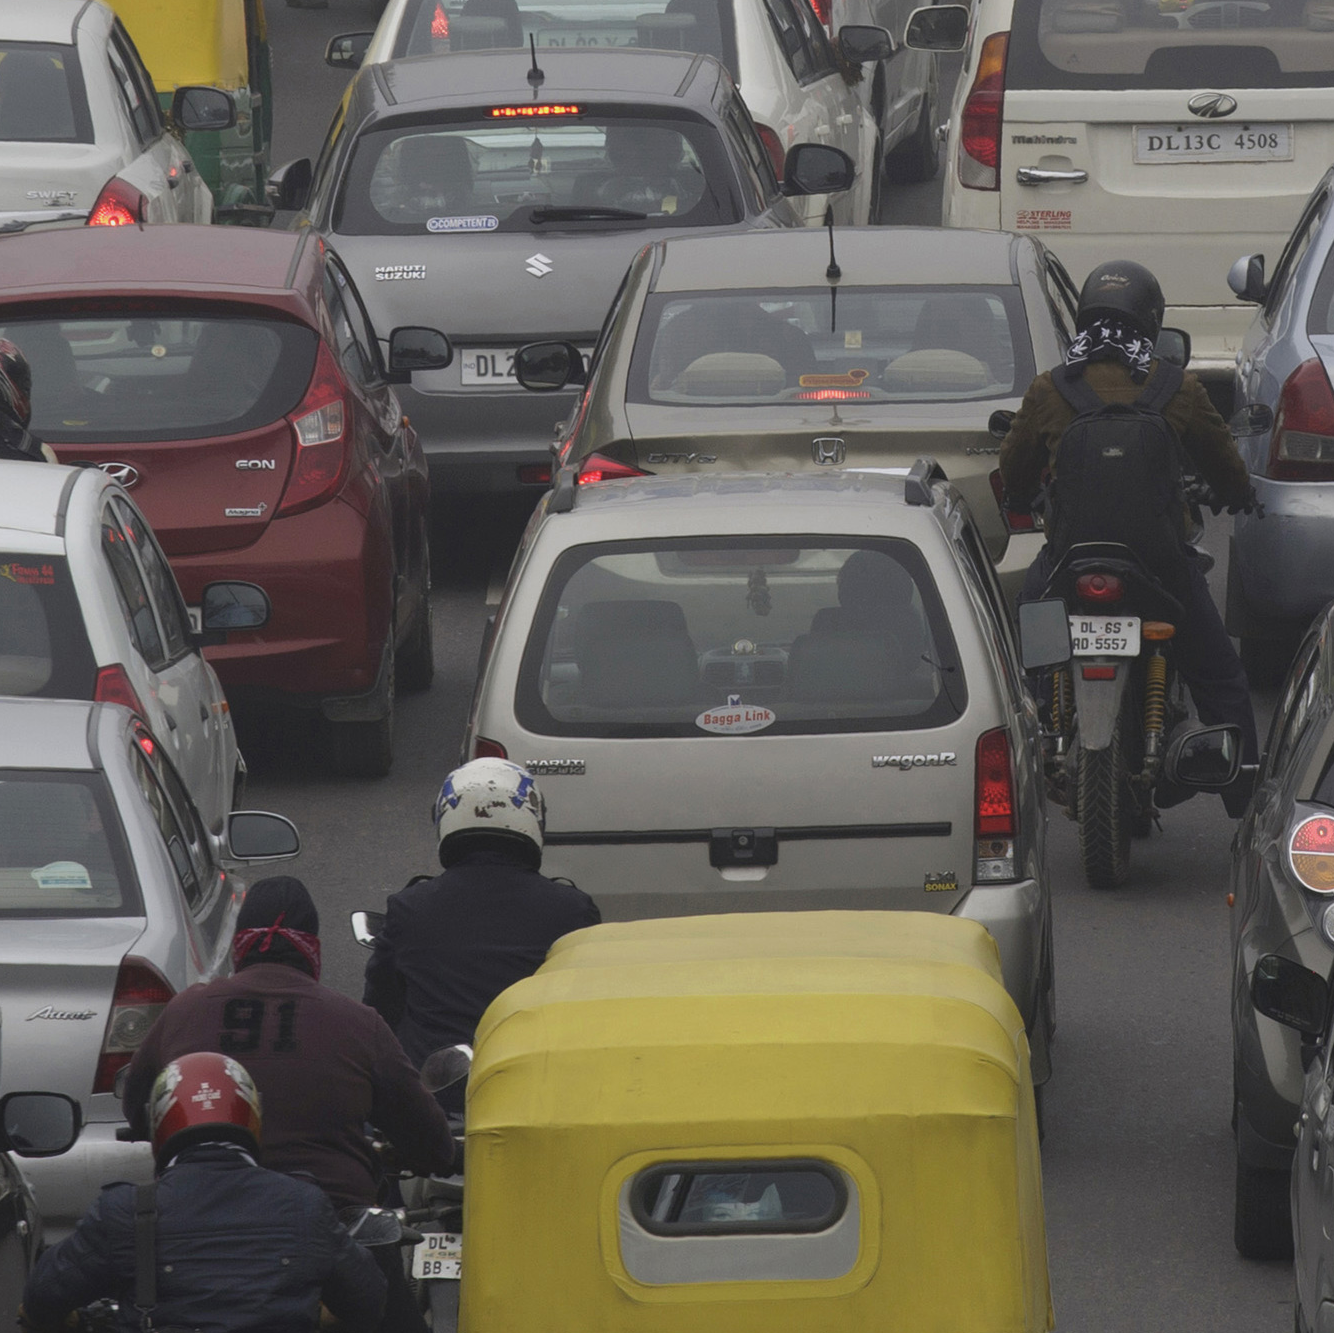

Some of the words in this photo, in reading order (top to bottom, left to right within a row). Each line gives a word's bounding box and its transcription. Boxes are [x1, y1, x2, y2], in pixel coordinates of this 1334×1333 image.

[1011, 135, 1078, 144] Mahindra
[1147, 132, 1221, 153] DL13C
[1234, 130, 1279, 150] 4508
[26, 190, 78, 199] SWIFT
[1030, 210, 1072, 218] STERLING
[438, 217, 487, 229] COMPETENT
[375, 272, 426, 281] SUZUKI
[235, 459, 276, 470] EON
[703, 713, 741, 727] Bagga
[745, 710, 770, 722] Link
[526, 759, 585, 767] MARUTI
[872, 752, 958, 771] wagonR
[925, 882, 957, 892] SONAX
[25, 1005, 98, 1022] Accent
[217, 997, 301, 1054] 91
[428, 1237, 447, 1249] DL
